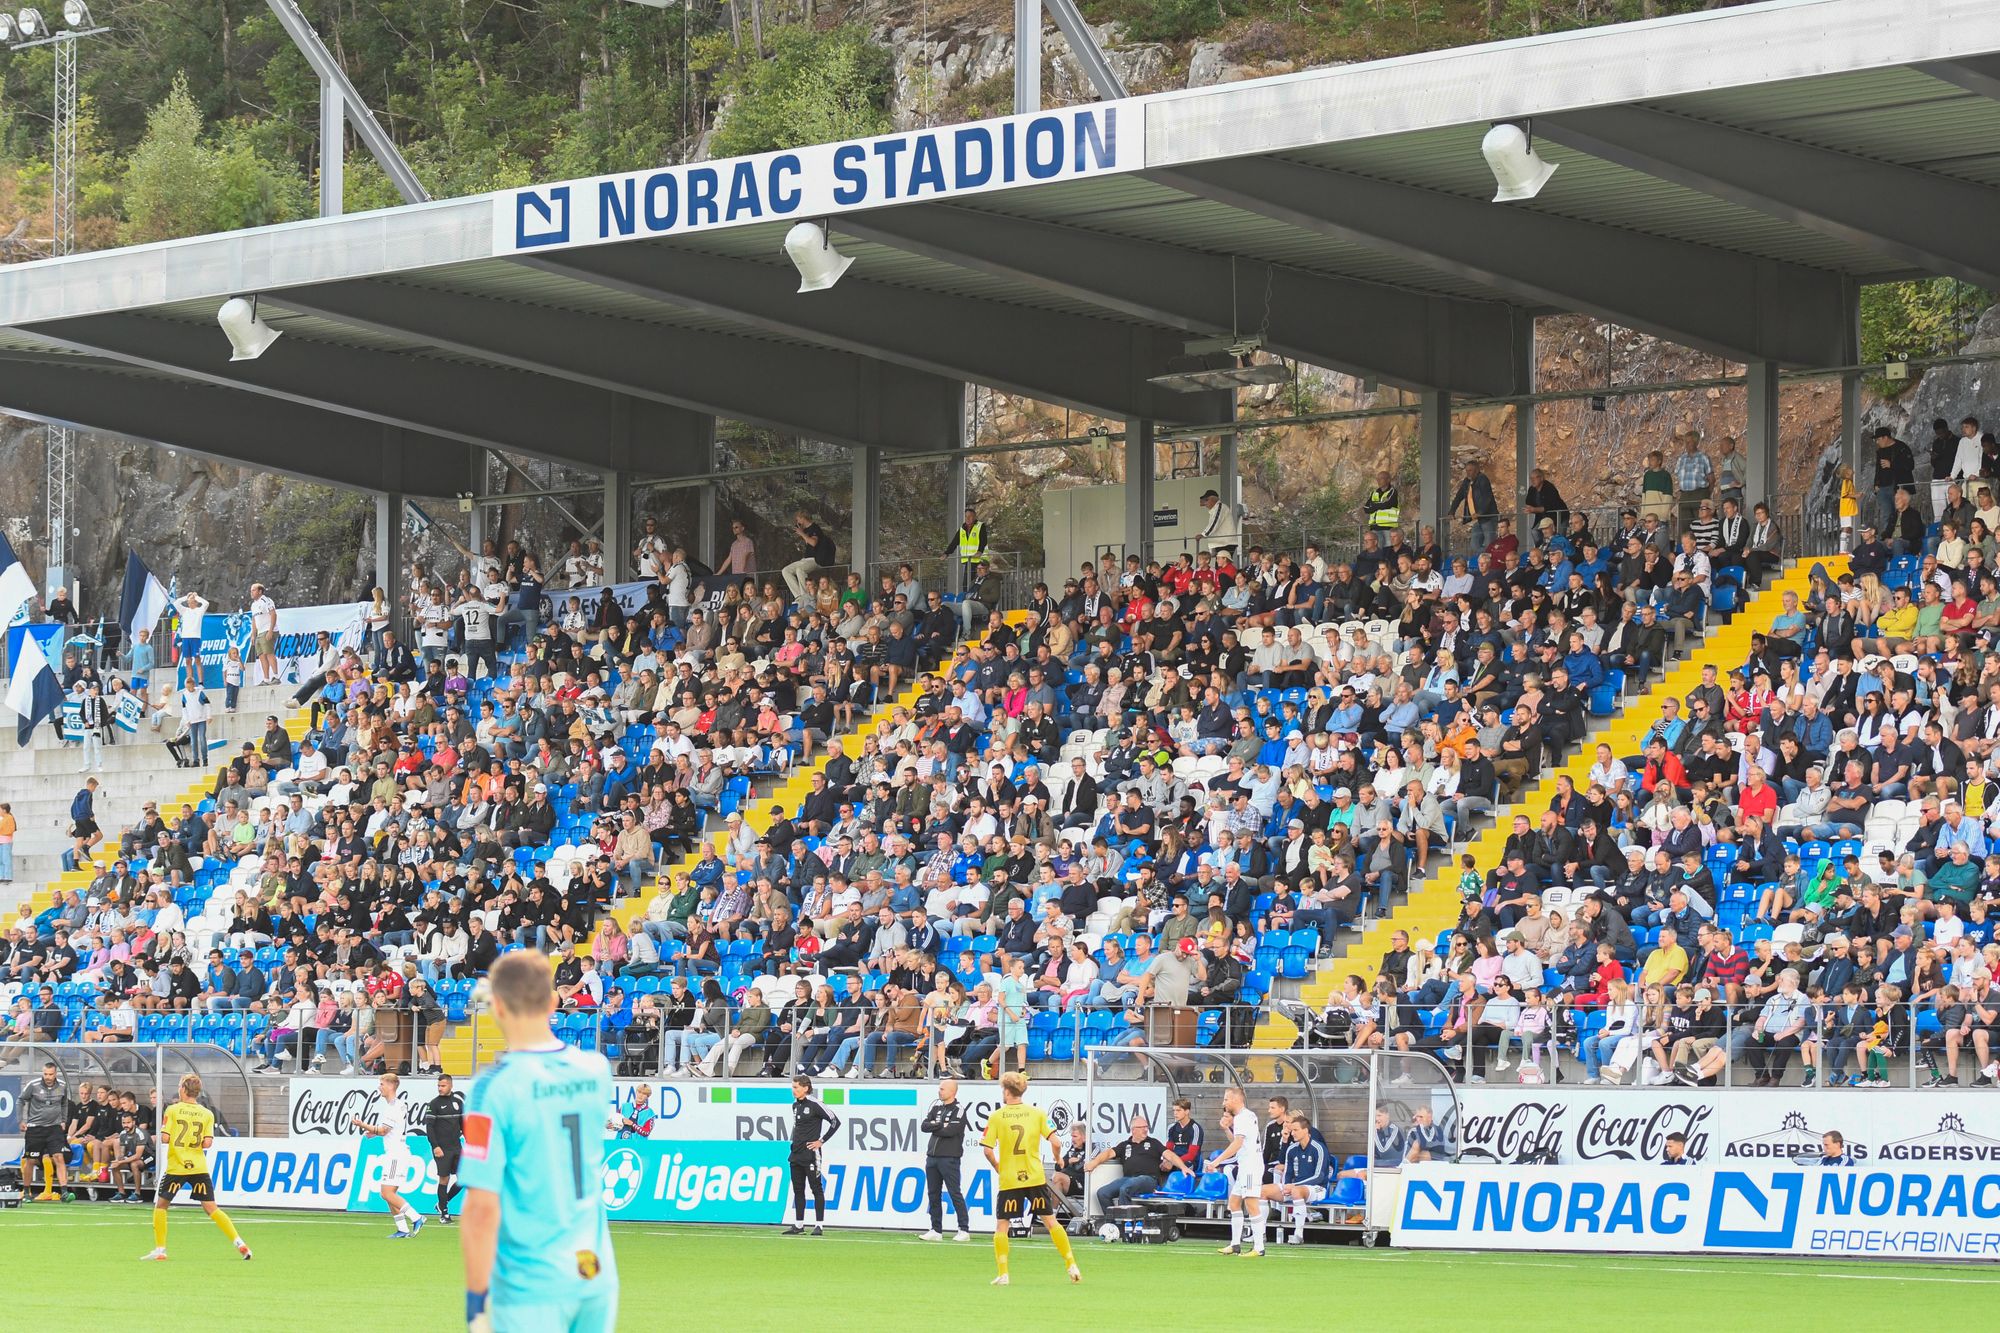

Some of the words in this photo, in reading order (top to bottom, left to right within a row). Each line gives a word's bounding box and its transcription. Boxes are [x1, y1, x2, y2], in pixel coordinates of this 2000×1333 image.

[599, 154, 802, 239] NORAC
[833, 106, 1117, 206] STADION
[466, 609, 480, 625] 12
[174, 1119, 204, 1149] 23
[848, 1117, 918, 1152] RSM
[1010, 1124, 1026, 1155] 2
[212, 1151, 352, 1195] NORAC
[561, 1113, 583, 1200] 1
[653, 1152, 783, 1211] ligaen
[1815, 1172, 2000, 1219] NORAC
[1472, 1181, 1691, 1235] NORAC
[1810, 1229, 2000, 1254] BADEKABINER
